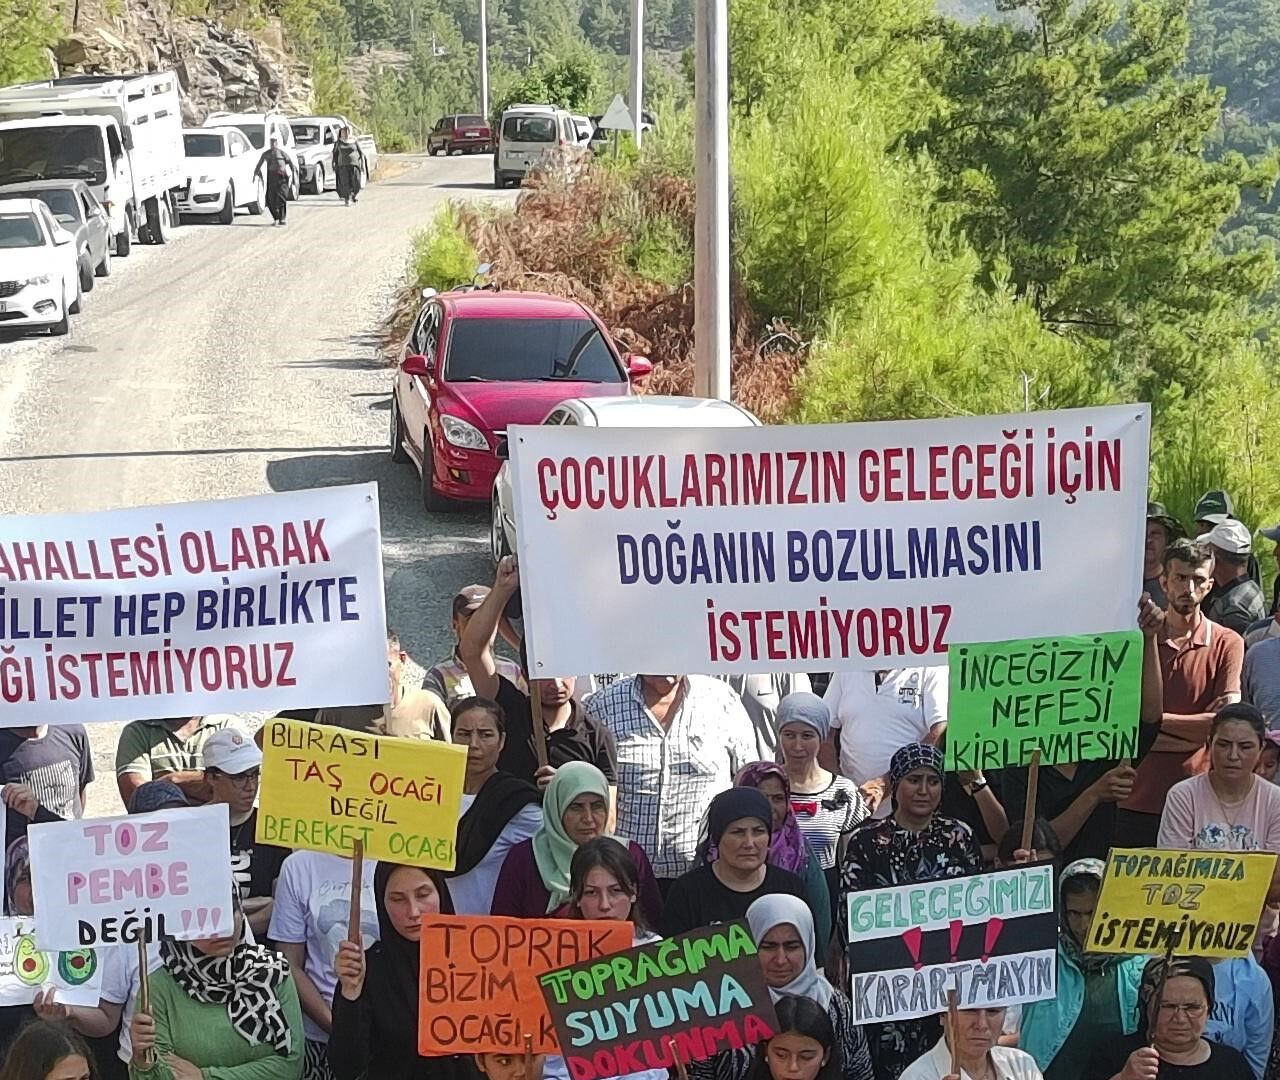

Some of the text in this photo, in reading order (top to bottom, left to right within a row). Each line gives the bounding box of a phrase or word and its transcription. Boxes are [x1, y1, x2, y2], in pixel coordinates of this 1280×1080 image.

[537, 425, 1122, 520] ÇOCUKLARIMIZIN GELECEĞİ İÇİN
[179, 518, 330, 577] OLARAK
[616, 520, 1043, 586] DOĞANIN BOZULMASINI
[114, 590, 186, 639] HEP
[195, 572, 360, 630] BİRLİKTE
[706, 596, 952, 662] İSTEMİYORUZ
[45, 639, 297, 699] İSTEMİYORUZ
[992, 680, 1115, 728] NEFESİ
[271, 722, 380, 760] BURASI
[953, 723, 1138, 771] KİRLENMESİN
[285, 758, 443, 805] TAŞ OCAĞI
[330, 796, 398, 825] DEĞİL
[83, 821, 169, 856] TOZ
[264, 815, 454, 863] BEREKET OCAĞI
[67, 861, 190, 905] PEMBE
[1113, 853, 1246, 882] TOPRAĞIMIZA
[1141, 883, 1206, 911] TOZ
[78, 907, 172, 946] DEĞİL
[427, 923, 613, 968] TOPRAK
[1093, 912, 1256, 951] İSTEMİYORUZ
[425, 962, 520, 1004] BİZİM
[540, 922, 758, 1005] TOPRAĞIMA
[565, 973, 753, 1048] SUYUMA
[854, 956, 1052, 1021] KARARTMAYIN
